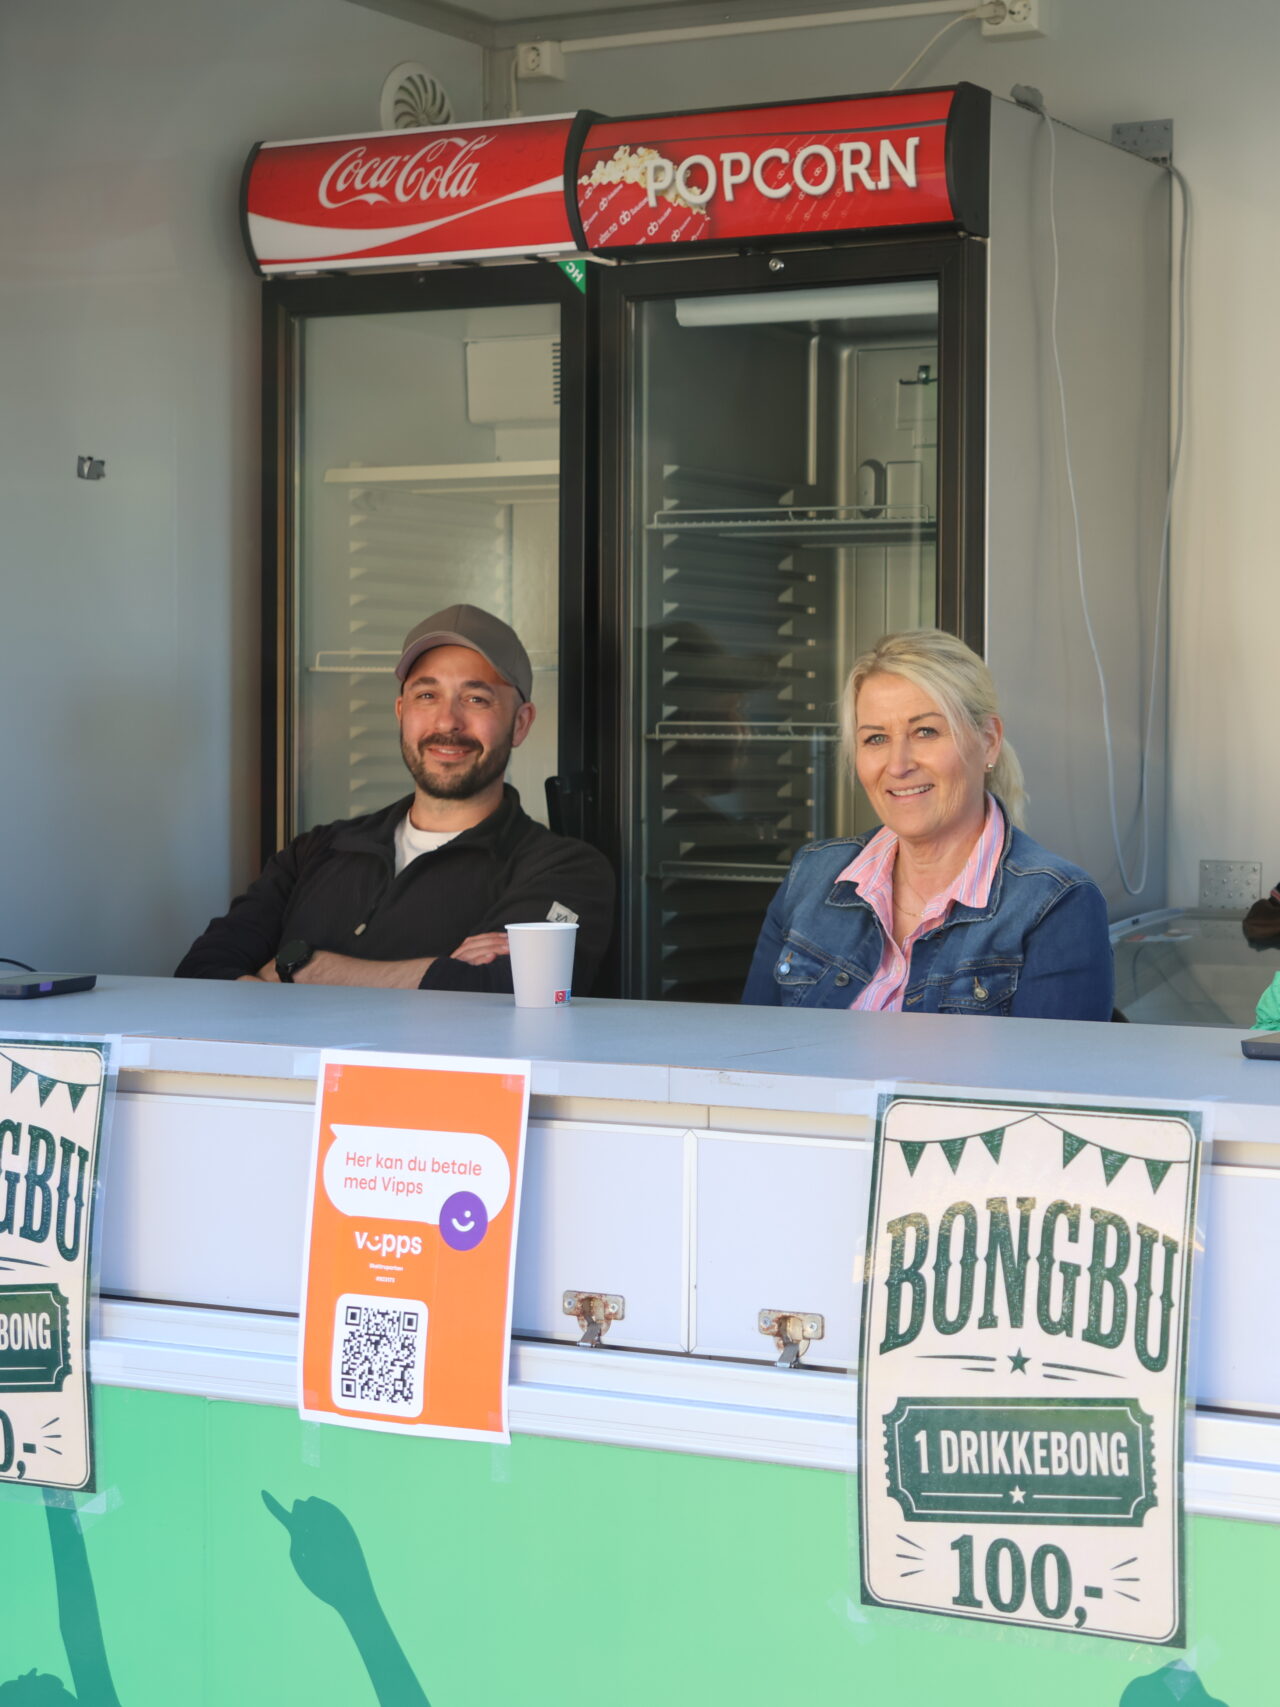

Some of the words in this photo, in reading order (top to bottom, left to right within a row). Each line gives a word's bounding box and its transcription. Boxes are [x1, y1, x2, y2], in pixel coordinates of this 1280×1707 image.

[318, 134, 497, 209] Coca-Cola
[647, 136, 920, 208] POPCORN
[343, 1176, 377, 1191] med
[382, 1176, 423, 1197] Vipps
[345, 1152, 373, 1168] Her
[375, 1153, 403, 1170] kan
[407, 1156, 427, 1172] du
[431, 1157, 482, 1176] betale
[879, 1196, 1179, 1373] BONGBU
[914, 1429, 930, 1475] 1
[940, 1430, 1130, 1478] DRIKKEBONG
[950, 1533, 1104, 1629] 100,-
